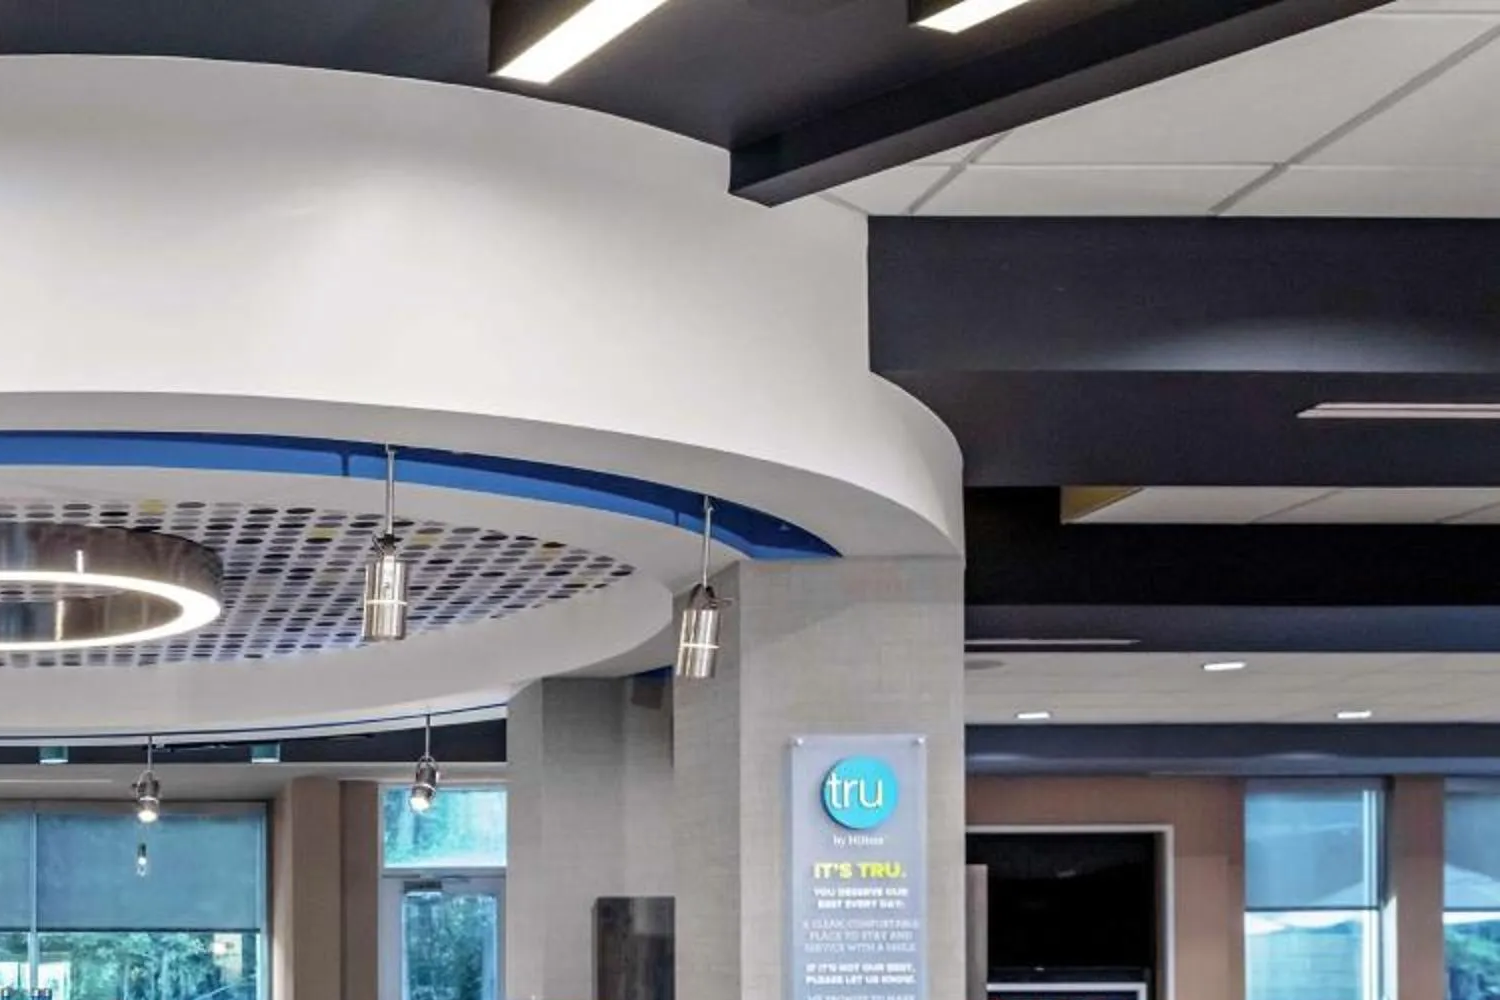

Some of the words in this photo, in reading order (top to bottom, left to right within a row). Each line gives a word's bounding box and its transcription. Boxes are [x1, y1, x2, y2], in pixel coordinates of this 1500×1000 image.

[827, 773, 884, 809] tru
[814, 862, 852, 879] IT'S
[856, 861, 908, 879] TRU.
